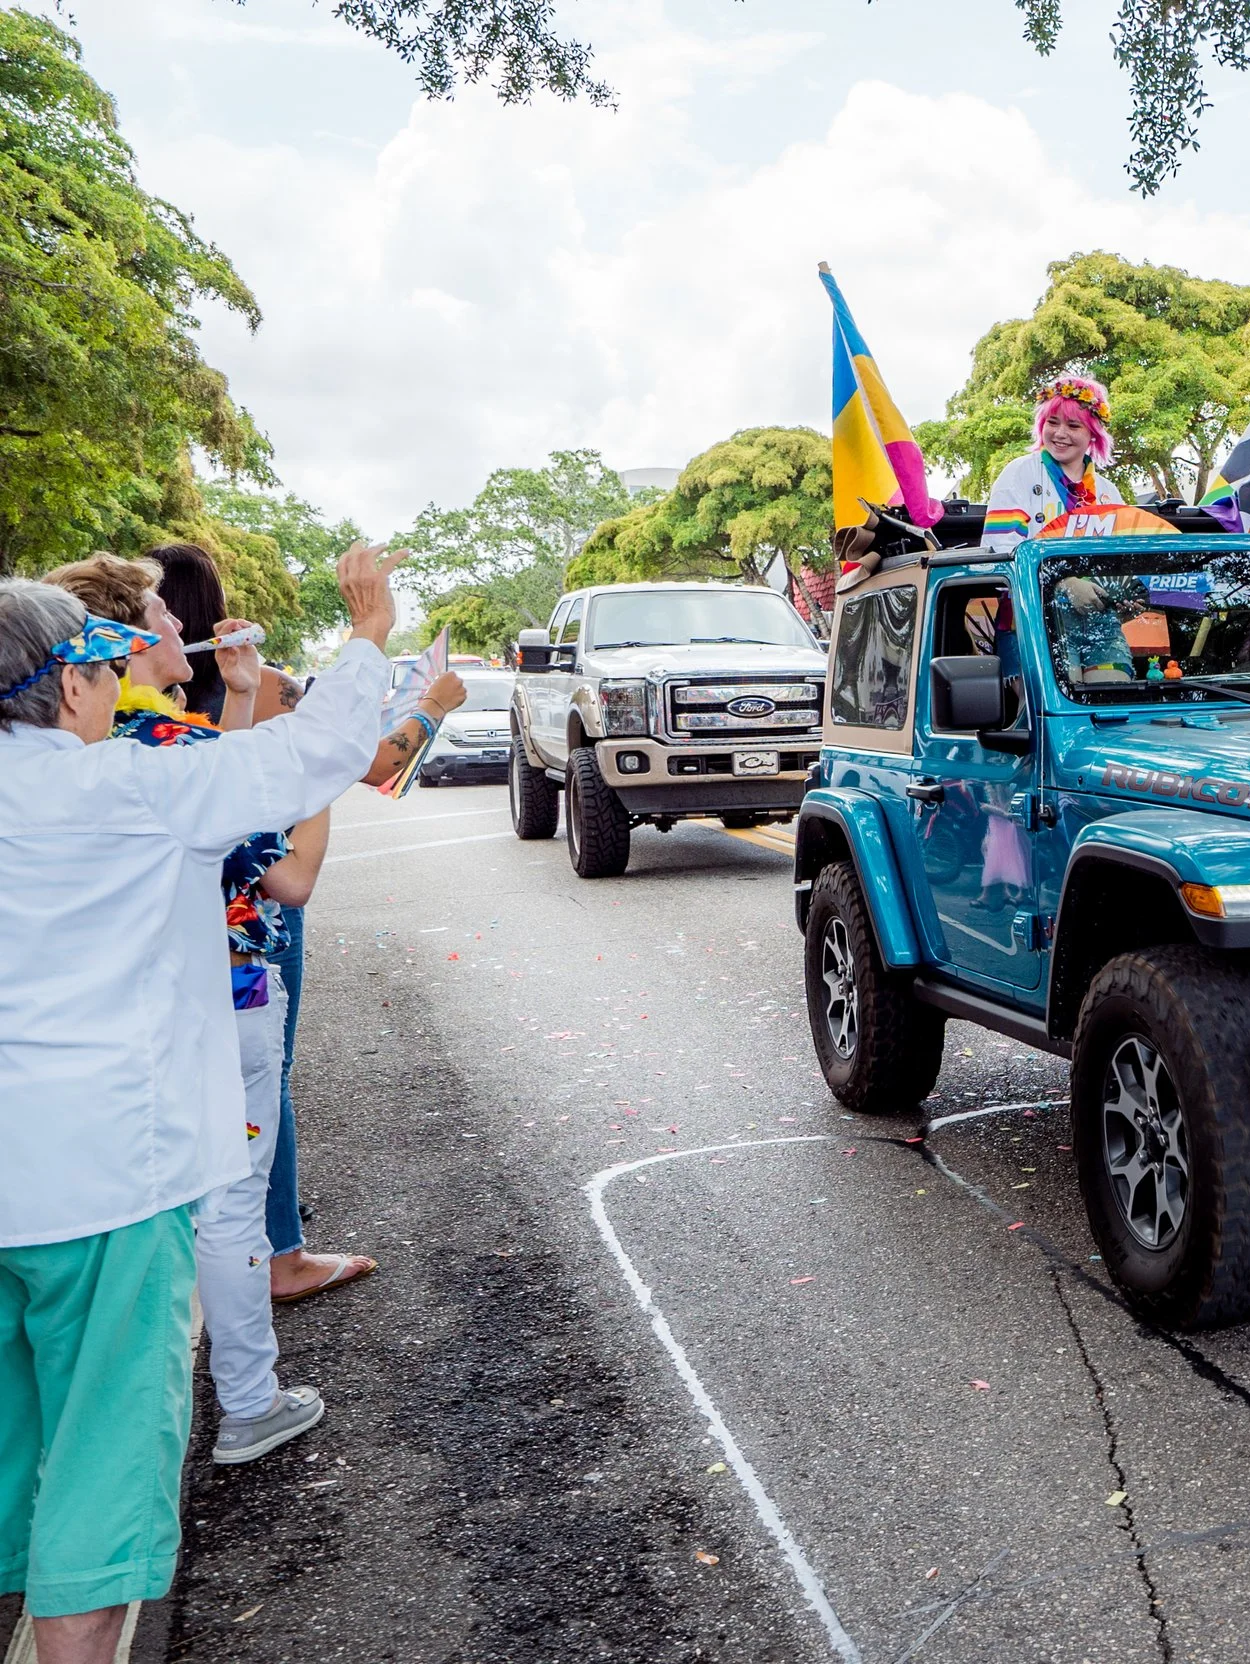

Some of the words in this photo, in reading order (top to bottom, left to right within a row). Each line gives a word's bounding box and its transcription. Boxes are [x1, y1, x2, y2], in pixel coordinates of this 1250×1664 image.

[1064, 513, 1117, 538] I'M
[1149, 575, 1198, 589] PRIDE
[738, 701, 766, 712] Ford
